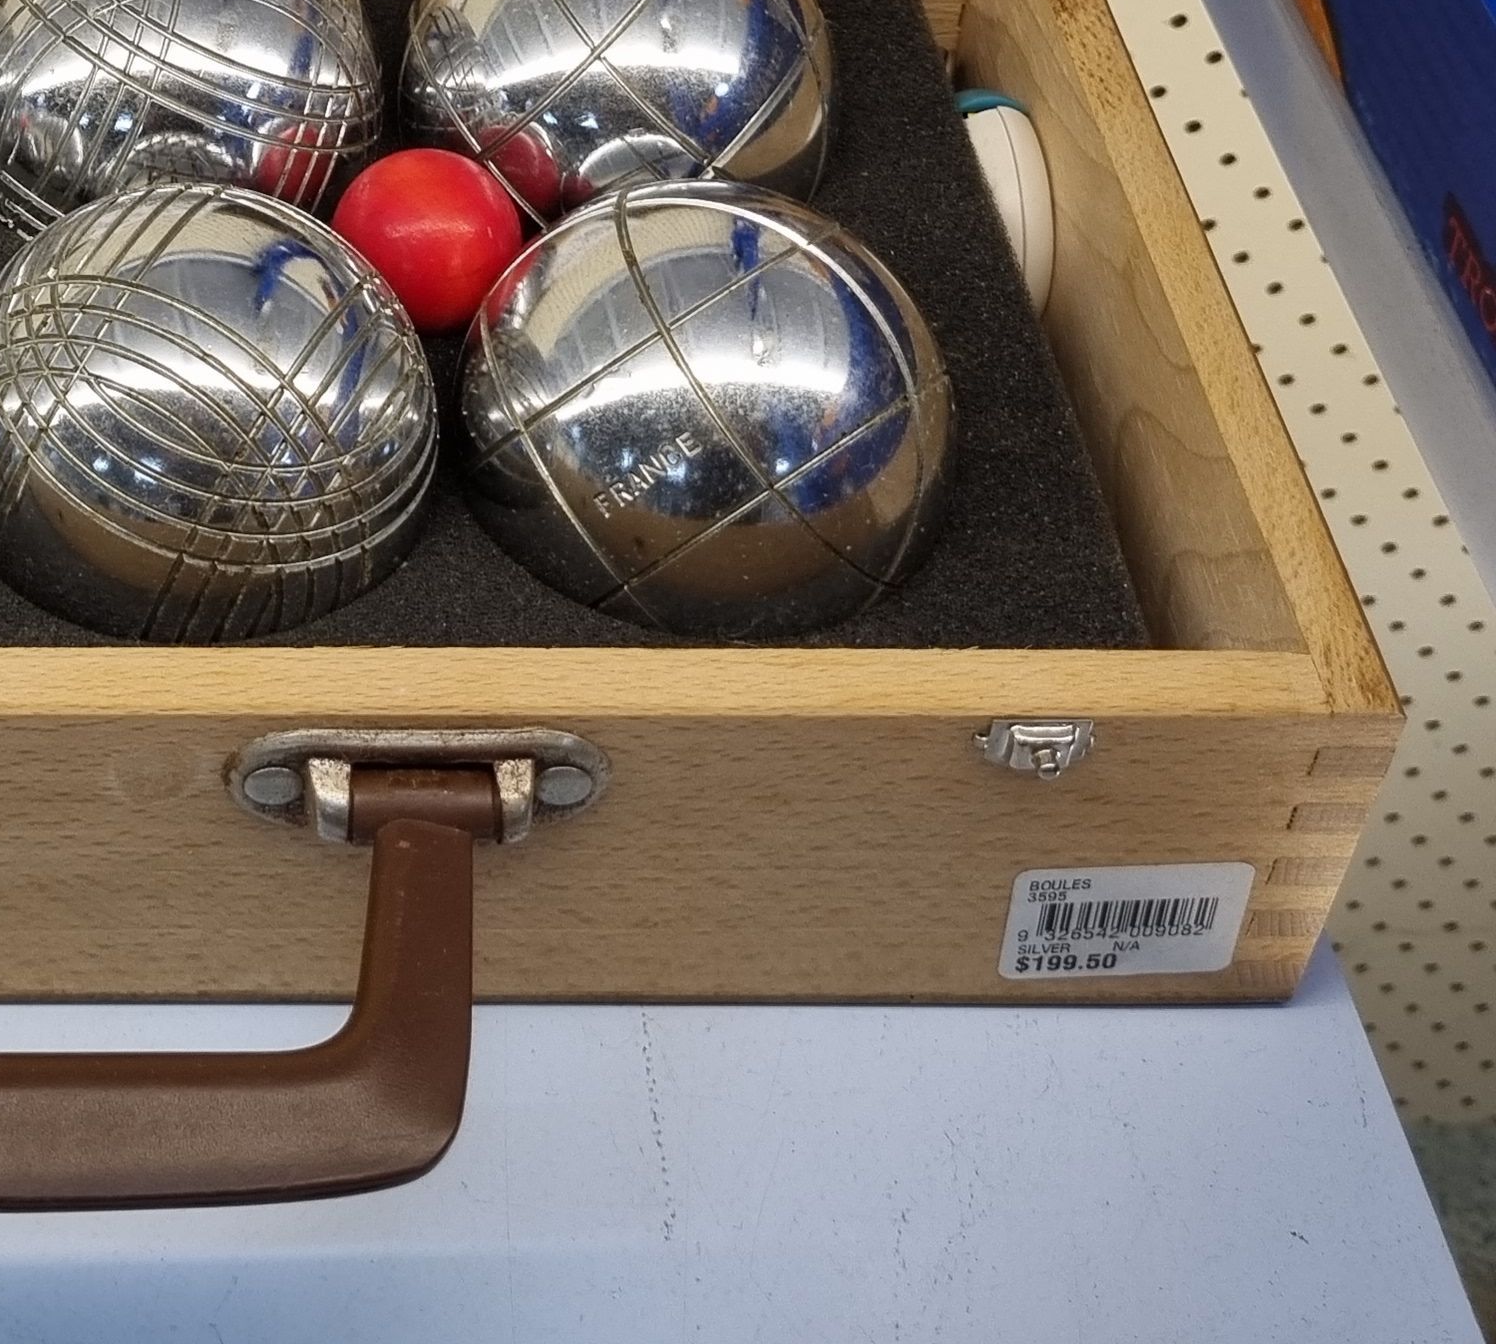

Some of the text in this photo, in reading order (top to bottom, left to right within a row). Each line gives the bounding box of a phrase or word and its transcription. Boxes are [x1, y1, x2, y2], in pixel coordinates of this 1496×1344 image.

[593, 431, 703, 519] FRANCE
[1029, 878, 1092, 891] BOULES
[1027, 891, 1067, 903] 3595
[1017, 929, 1029, 942] 9
[1017, 939, 1141, 955] SILVER N/A
[1015, 952, 1118, 973] $199.50
